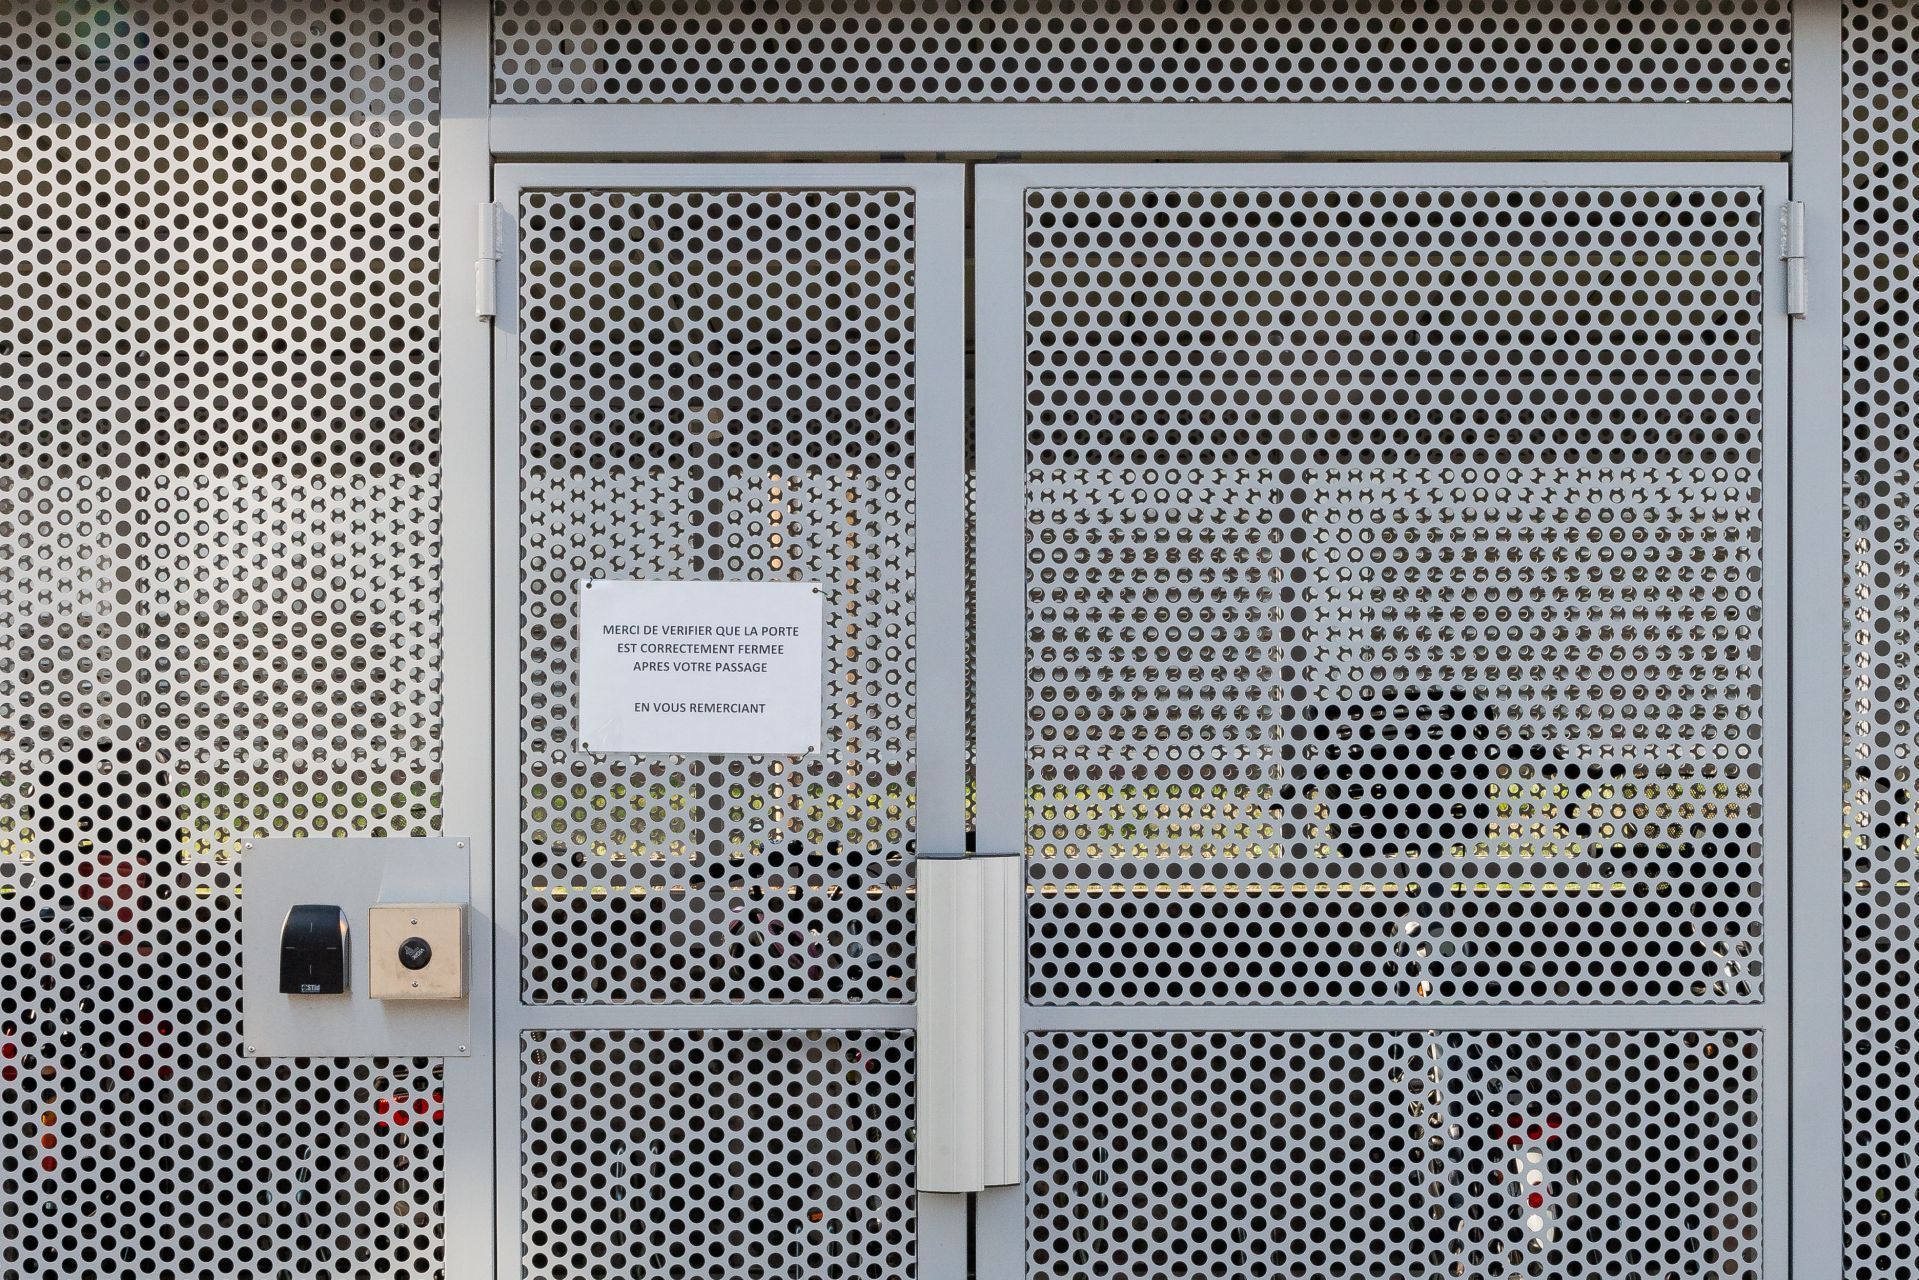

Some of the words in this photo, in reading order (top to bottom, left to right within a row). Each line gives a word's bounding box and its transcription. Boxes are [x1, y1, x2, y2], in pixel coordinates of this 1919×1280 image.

[603, 625, 640, 636] MERCI
[643, 625, 659, 635] DE
[662, 625, 713, 637] VERIFIER
[716, 626, 741, 637] QUE
[744, 626, 758, 636] LA
[761, 626, 799, 637] PORTE
[617, 643, 637, 653] EST
[640, 643, 735, 655] CORRECTEMENT
[738, 644, 784, 655] FERMEE
[633, 661, 670, 672] APRES
[673, 662, 712, 672] VOTRE
[715, 662, 768, 673] PASSAGE
[634, 702, 650, 713] EN
[653, 702, 686, 713] VOUS
[689, 703, 766, 714] REMERCIANT
